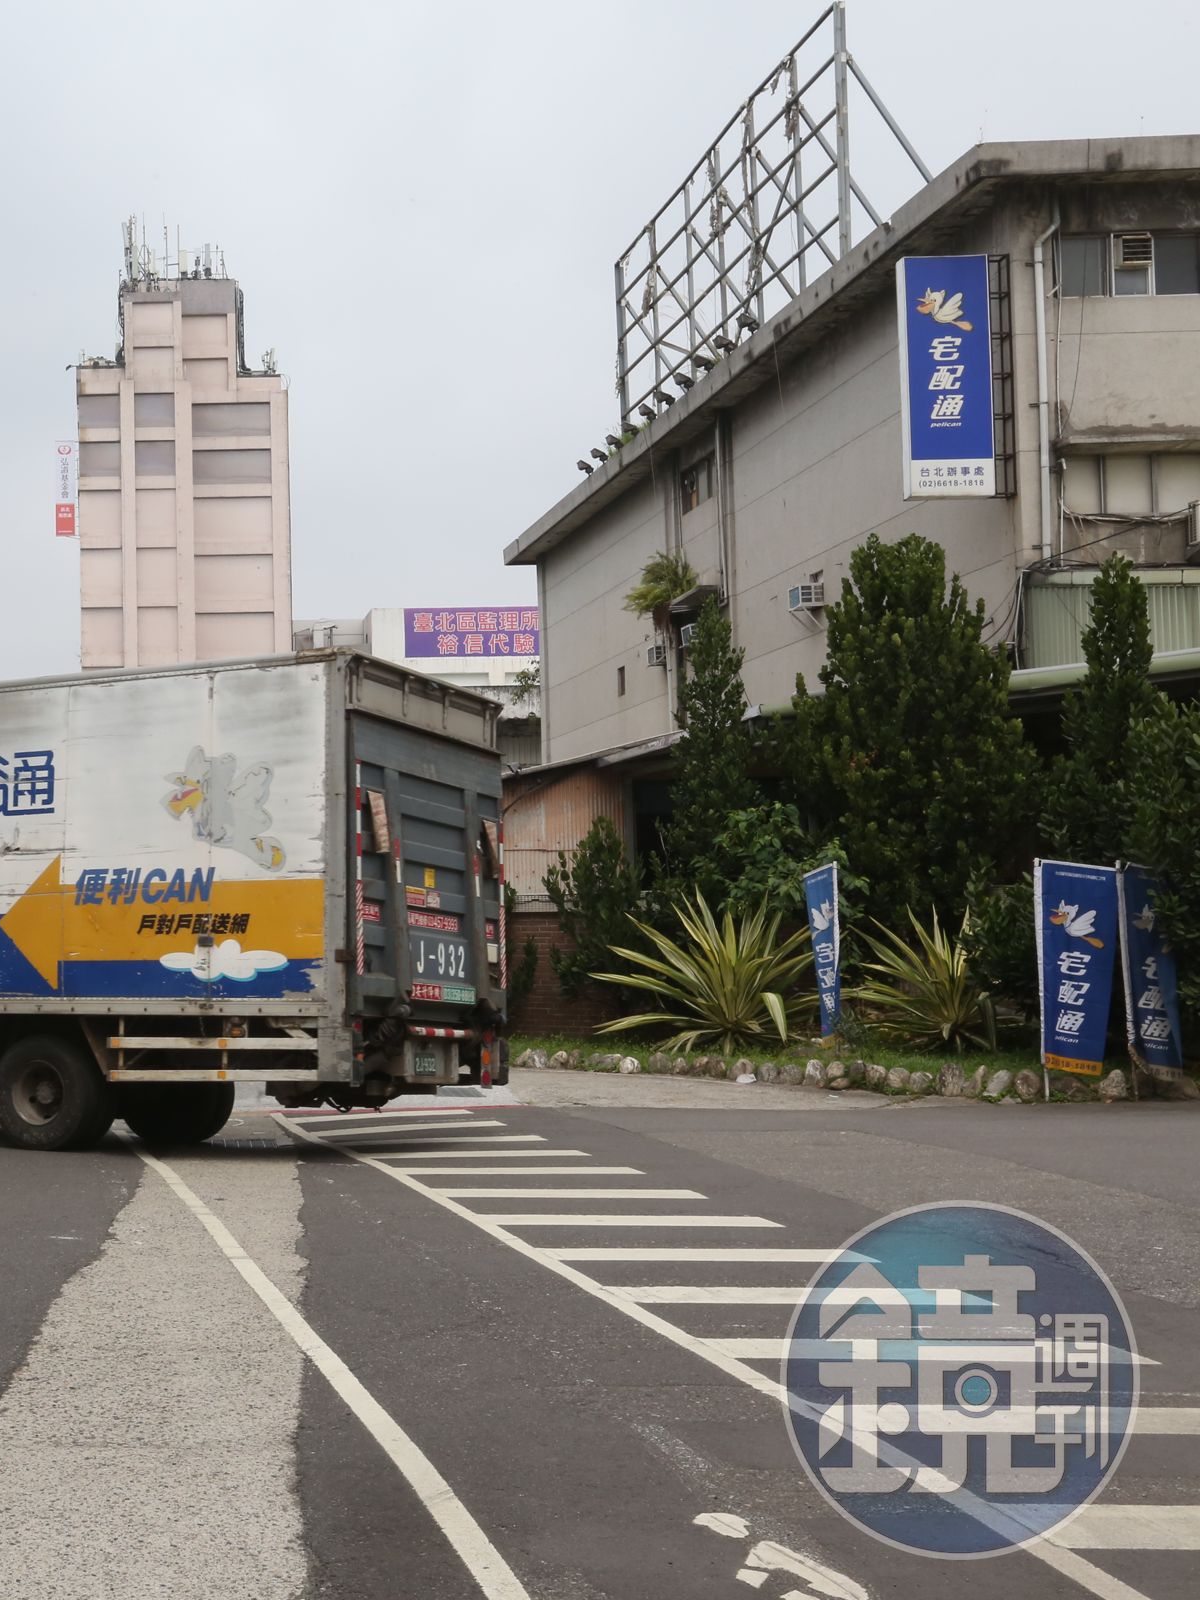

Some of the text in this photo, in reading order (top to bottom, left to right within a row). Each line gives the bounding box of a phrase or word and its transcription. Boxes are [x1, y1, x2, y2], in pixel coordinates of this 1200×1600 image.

[928, 336, 965, 419] 宅配通
[920, 466, 985, 478] 台北辦事處
[918, 479, 985, 488] (02)6618-1818
[413, 610, 540, 632] 臺北區監理所
[437, 633, 535, 654] 裕信代驗
[74, 866, 216, 905] 便利CAN
[137, 913, 250, 935] 戶對戶配送網
[409, 940, 465, 978] J-932
[1055, 951, 1091, 1035] 宅配通
